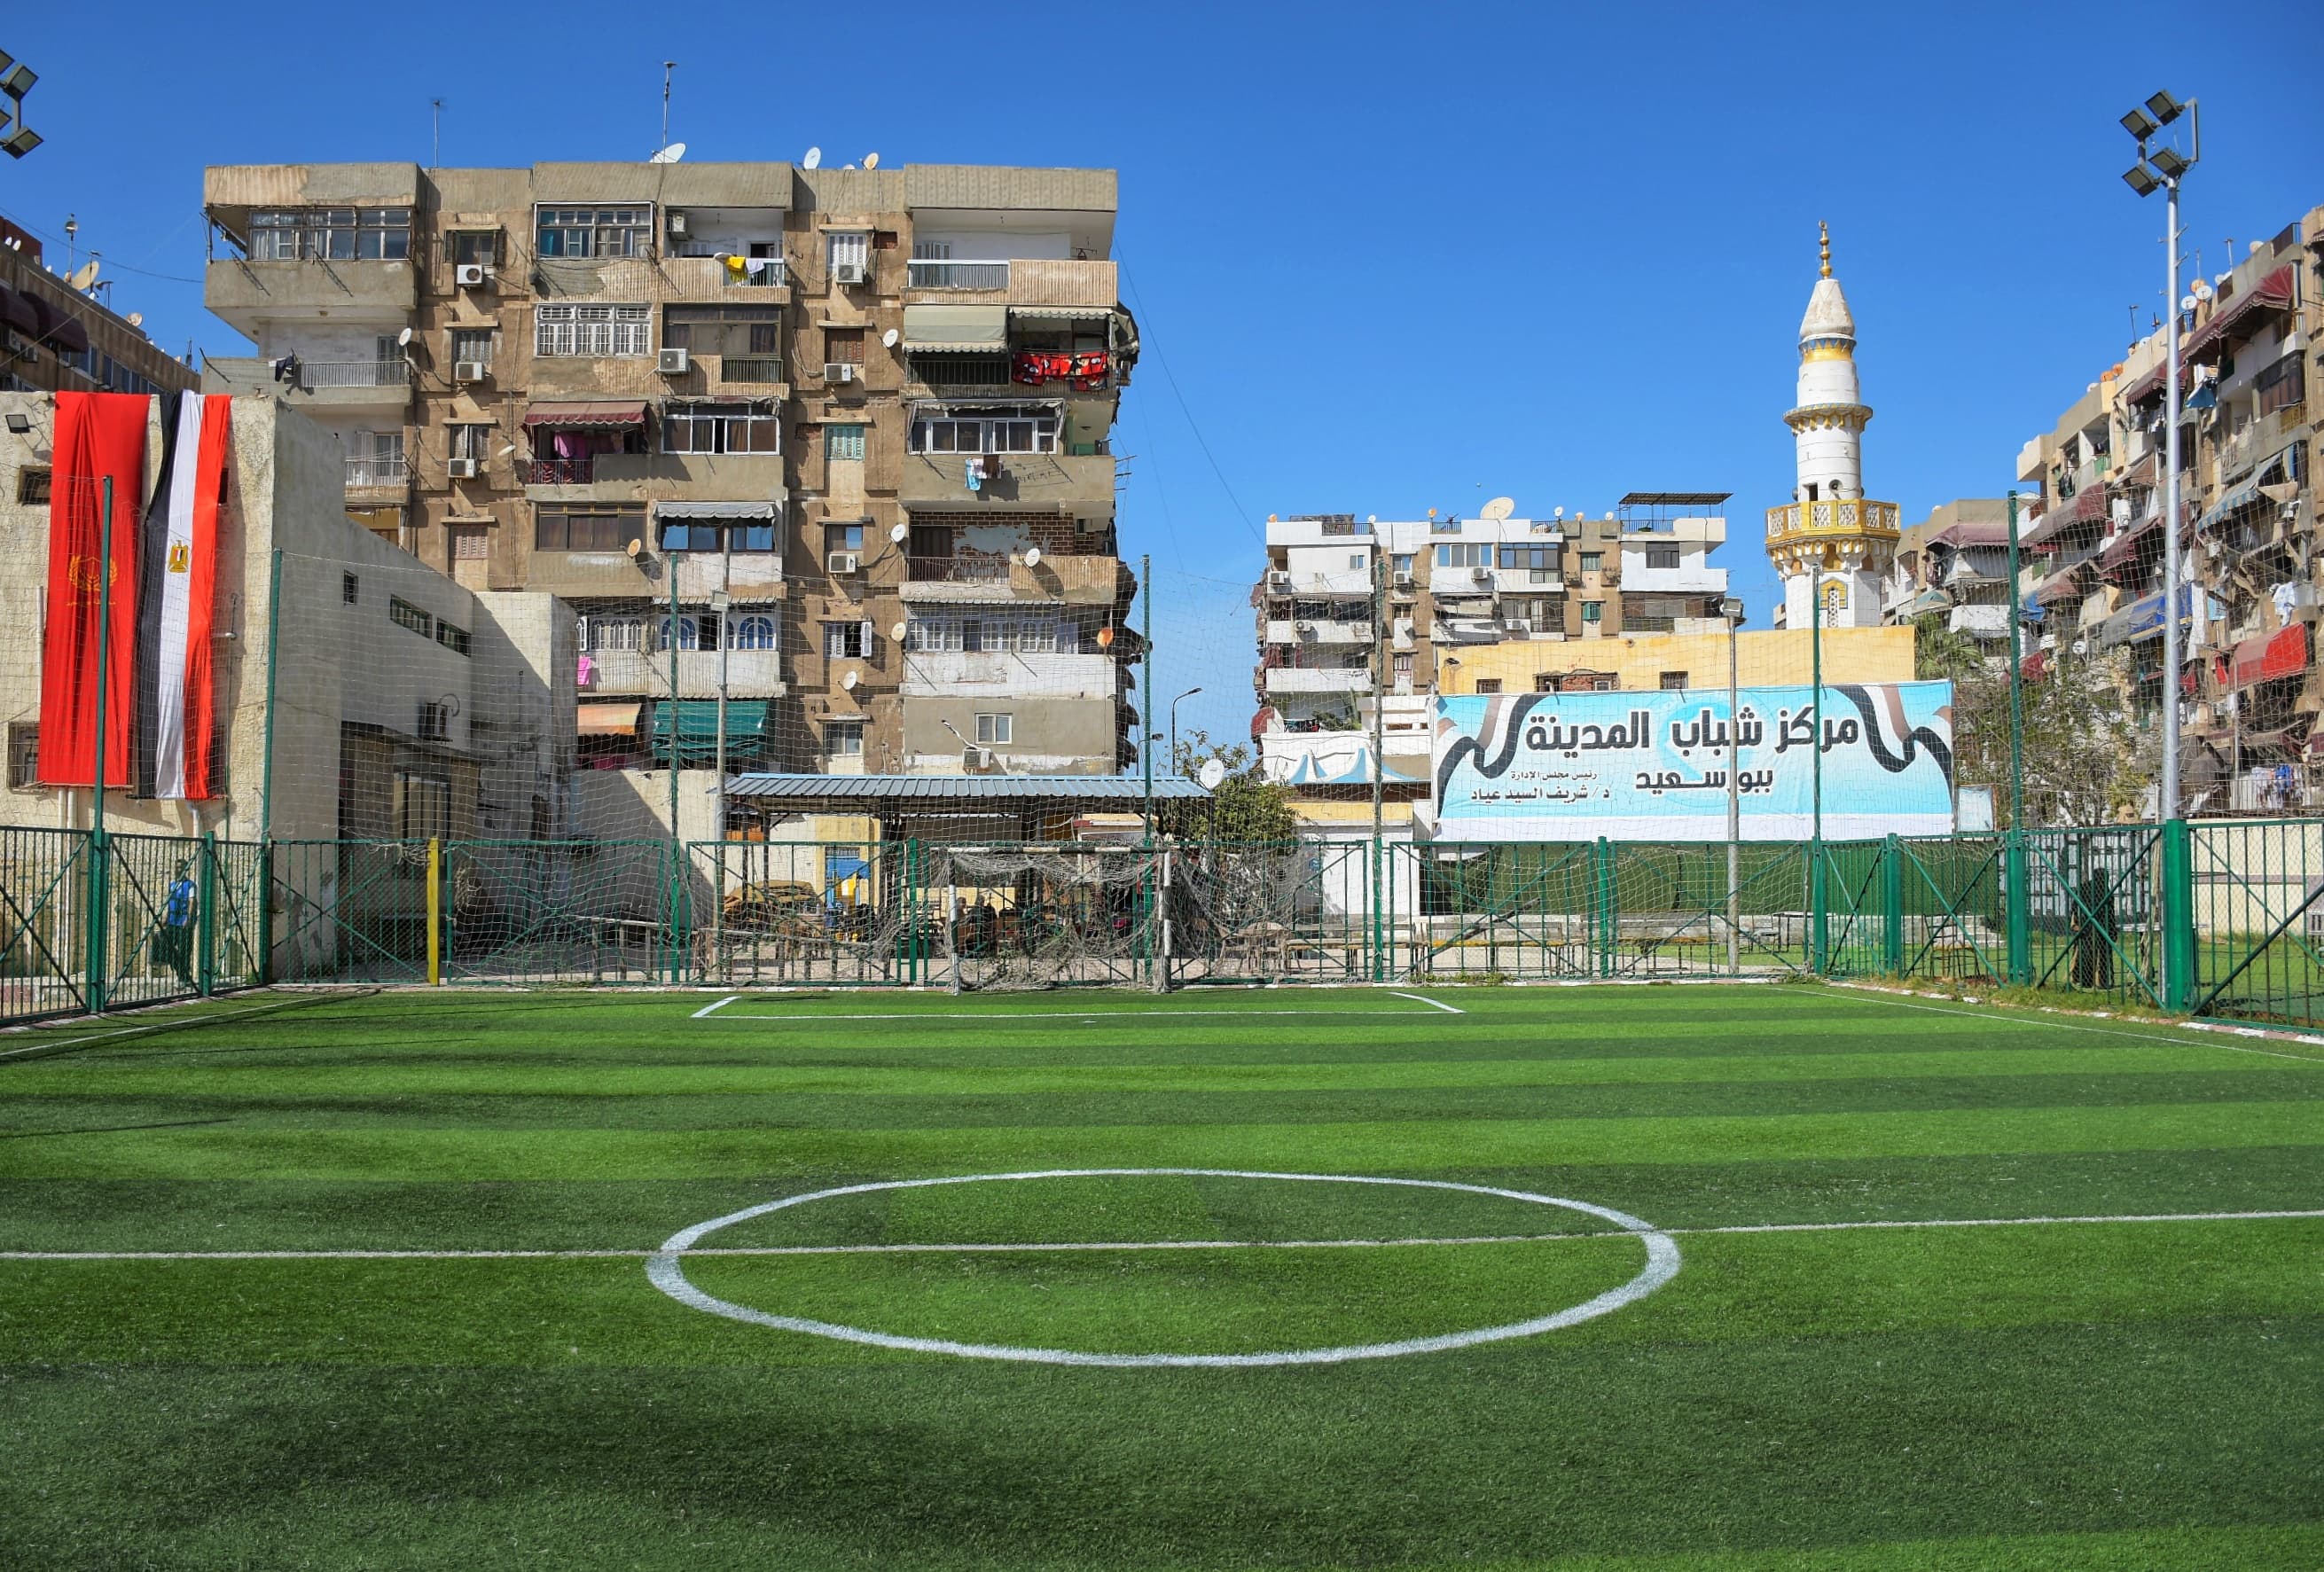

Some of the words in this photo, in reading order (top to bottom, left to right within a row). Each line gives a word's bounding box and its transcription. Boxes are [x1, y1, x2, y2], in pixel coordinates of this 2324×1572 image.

[1526, 711, 1649, 758] المدينة
[1672, 707, 1762, 756] شباب
[1774, 707, 1858, 754] مركز
[1542, 770, 1569, 781] مجلس
[1571, 770, 1597, 780] رئيس
[1636, 770, 1773, 794] ببوسعيد
[1471, 788, 1500, 803] عياد
[1506, 786, 1543, 803] السيد
[1546, 785, 1588, 803] شريف
